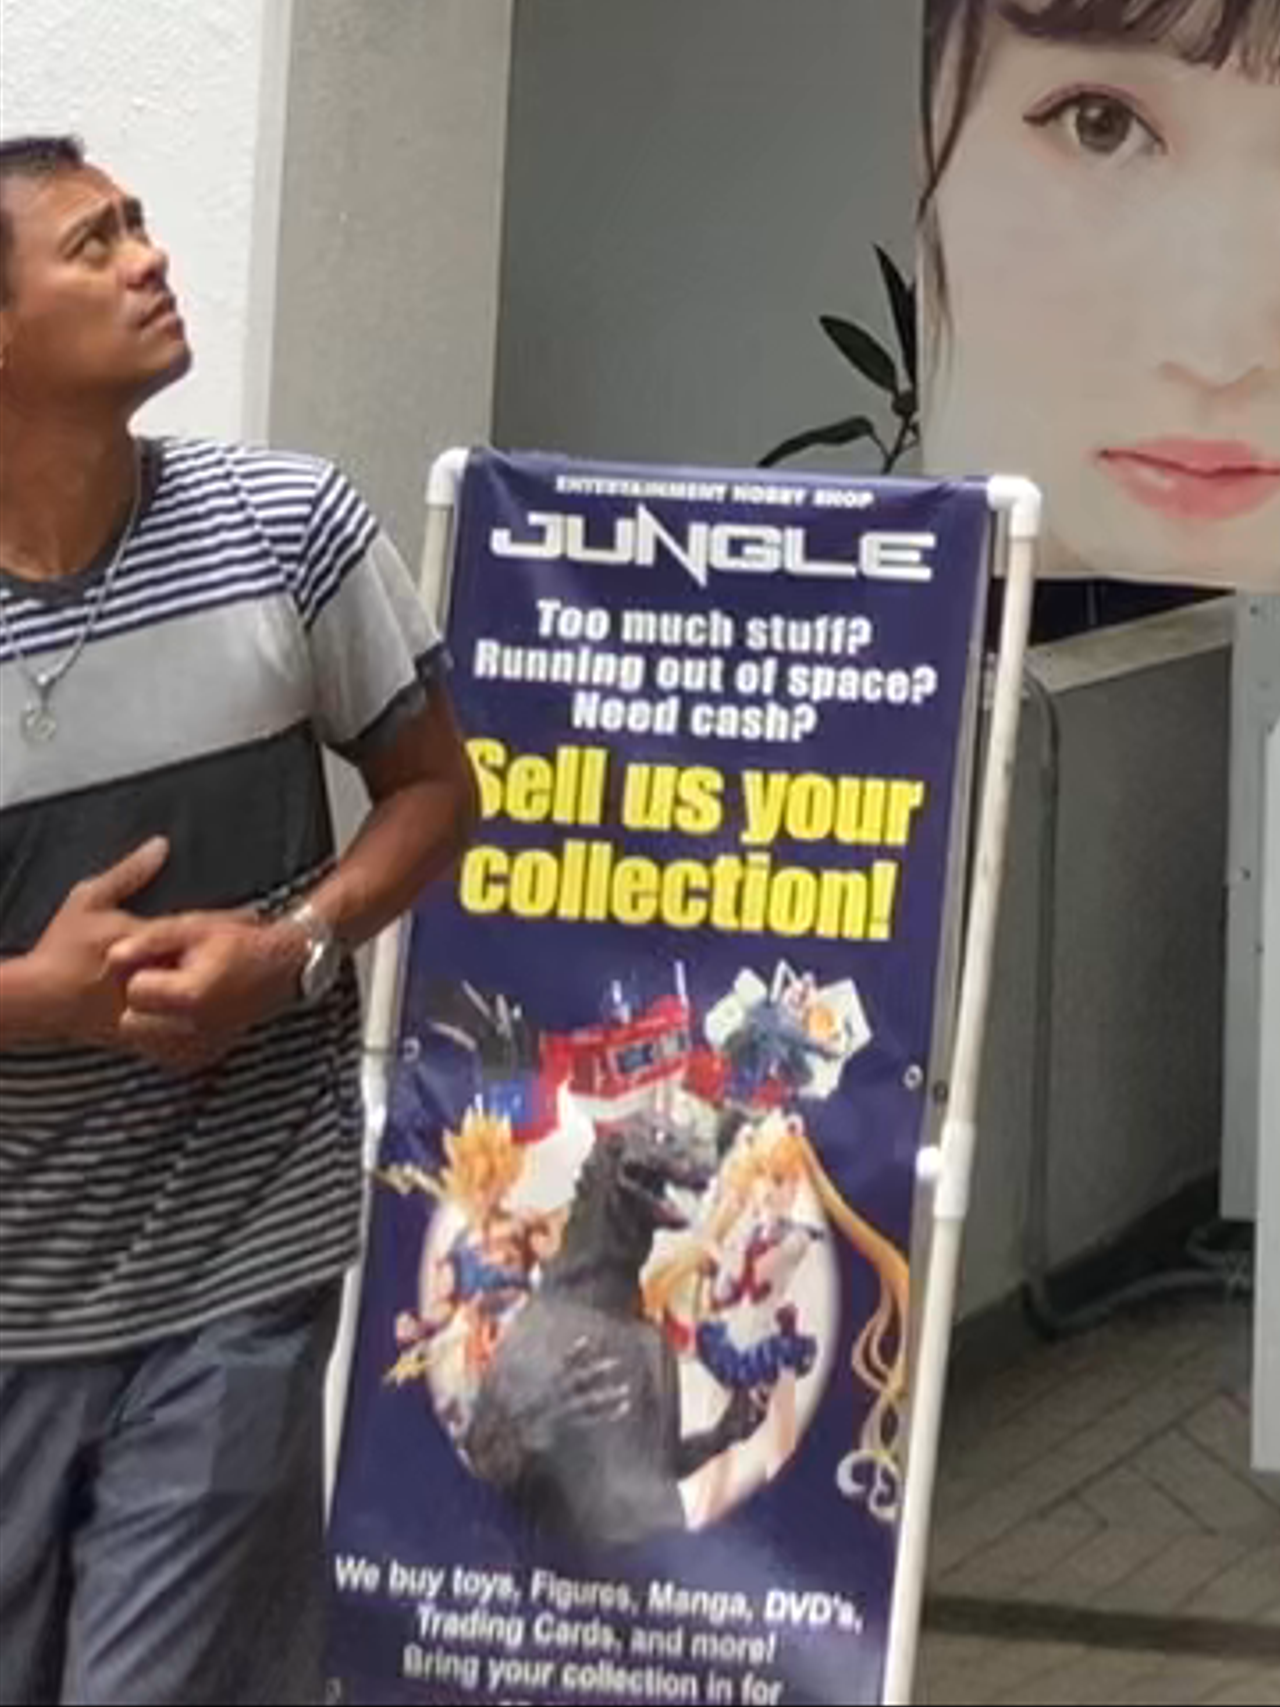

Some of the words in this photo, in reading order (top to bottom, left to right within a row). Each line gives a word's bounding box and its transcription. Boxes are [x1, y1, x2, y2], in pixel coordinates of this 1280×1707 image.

[812, 488, 874, 510] SHOP
[490, 503, 936, 589] JUNGLE
[536, 598, 611, 640] Too
[621, 610, 733, 648] much
[746, 615, 873, 655] stuff?
[474, 638, 645, 692] Running
[656, 656, 723, 692] out
[735, 657, 777, 696] of
[787, 664, 938, 704] space?
[572, 691, 680, 734] Need
[690, 701, 818, 742] cash?
[464, 737, 608, 827] Sell
[621, 762, 725, 836] us
[740, 769, 925, 847] your
[459, 838, 900, 941] collection!
[334, 1556, 380, 1591] We
[389, 1561, 444, 1600] buy
[416, 1604, 523, 1646] Trading
[630, 1625, 687, 1657] and
[692, 1631, 777, 1664] more!
[404, 1643, 481, 1688] Bring
[488, 1657, 556, 1690] your
[562, 1659, 699, 1696] collection
[706, 1668, 733, 1699] in
[740, 1676, 782, 1706] for
